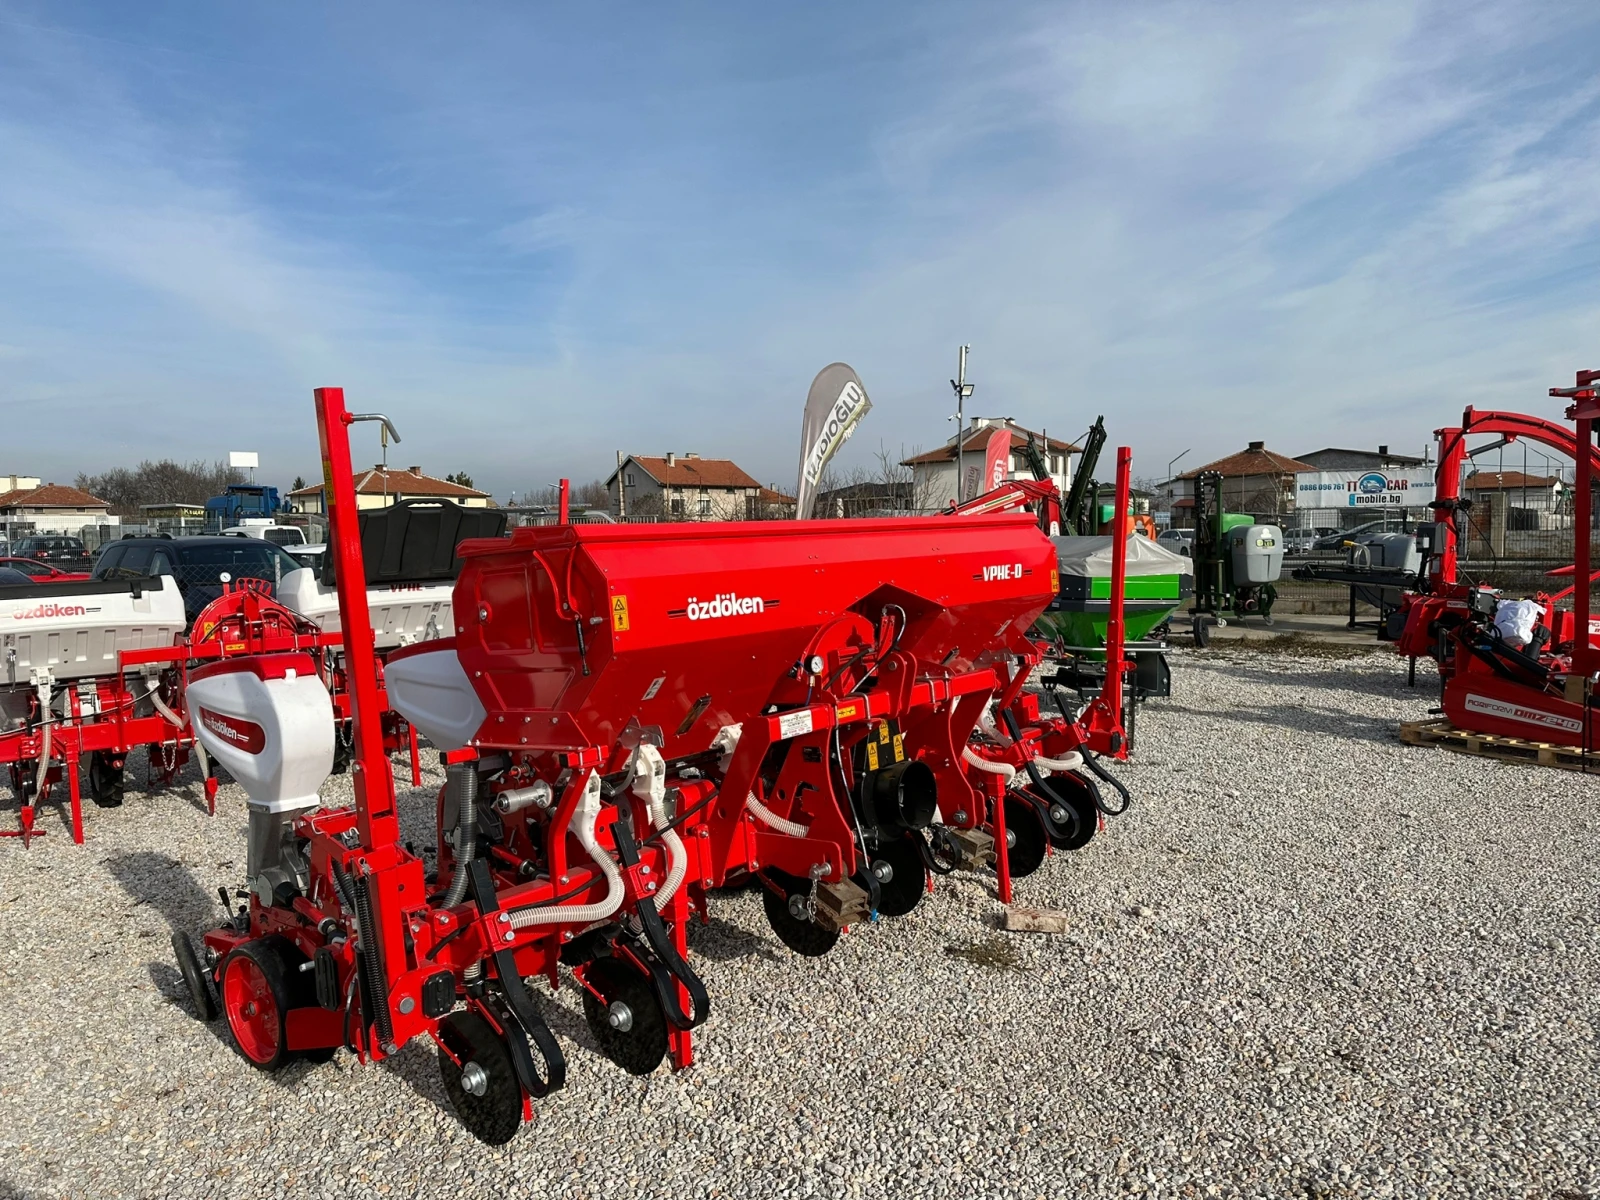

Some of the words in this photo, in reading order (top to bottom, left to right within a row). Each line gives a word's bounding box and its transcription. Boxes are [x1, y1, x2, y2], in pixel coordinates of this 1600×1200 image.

[1318, 483, 1332, 491] 096
[1333, 483, 1345, 491] 761
[1346, 481, 1358, 492] TT
[1387, 479, 1408, 491] CAR
[1356, 494, 1401, 504] mobile.bg
[982, 563, 1022, 582] VPHE-D
[390, 583, 424, 592] VPHE
[687, 592, 764, 621] özdöken
[1467, 699, 1513, 714] AGRIFORM
